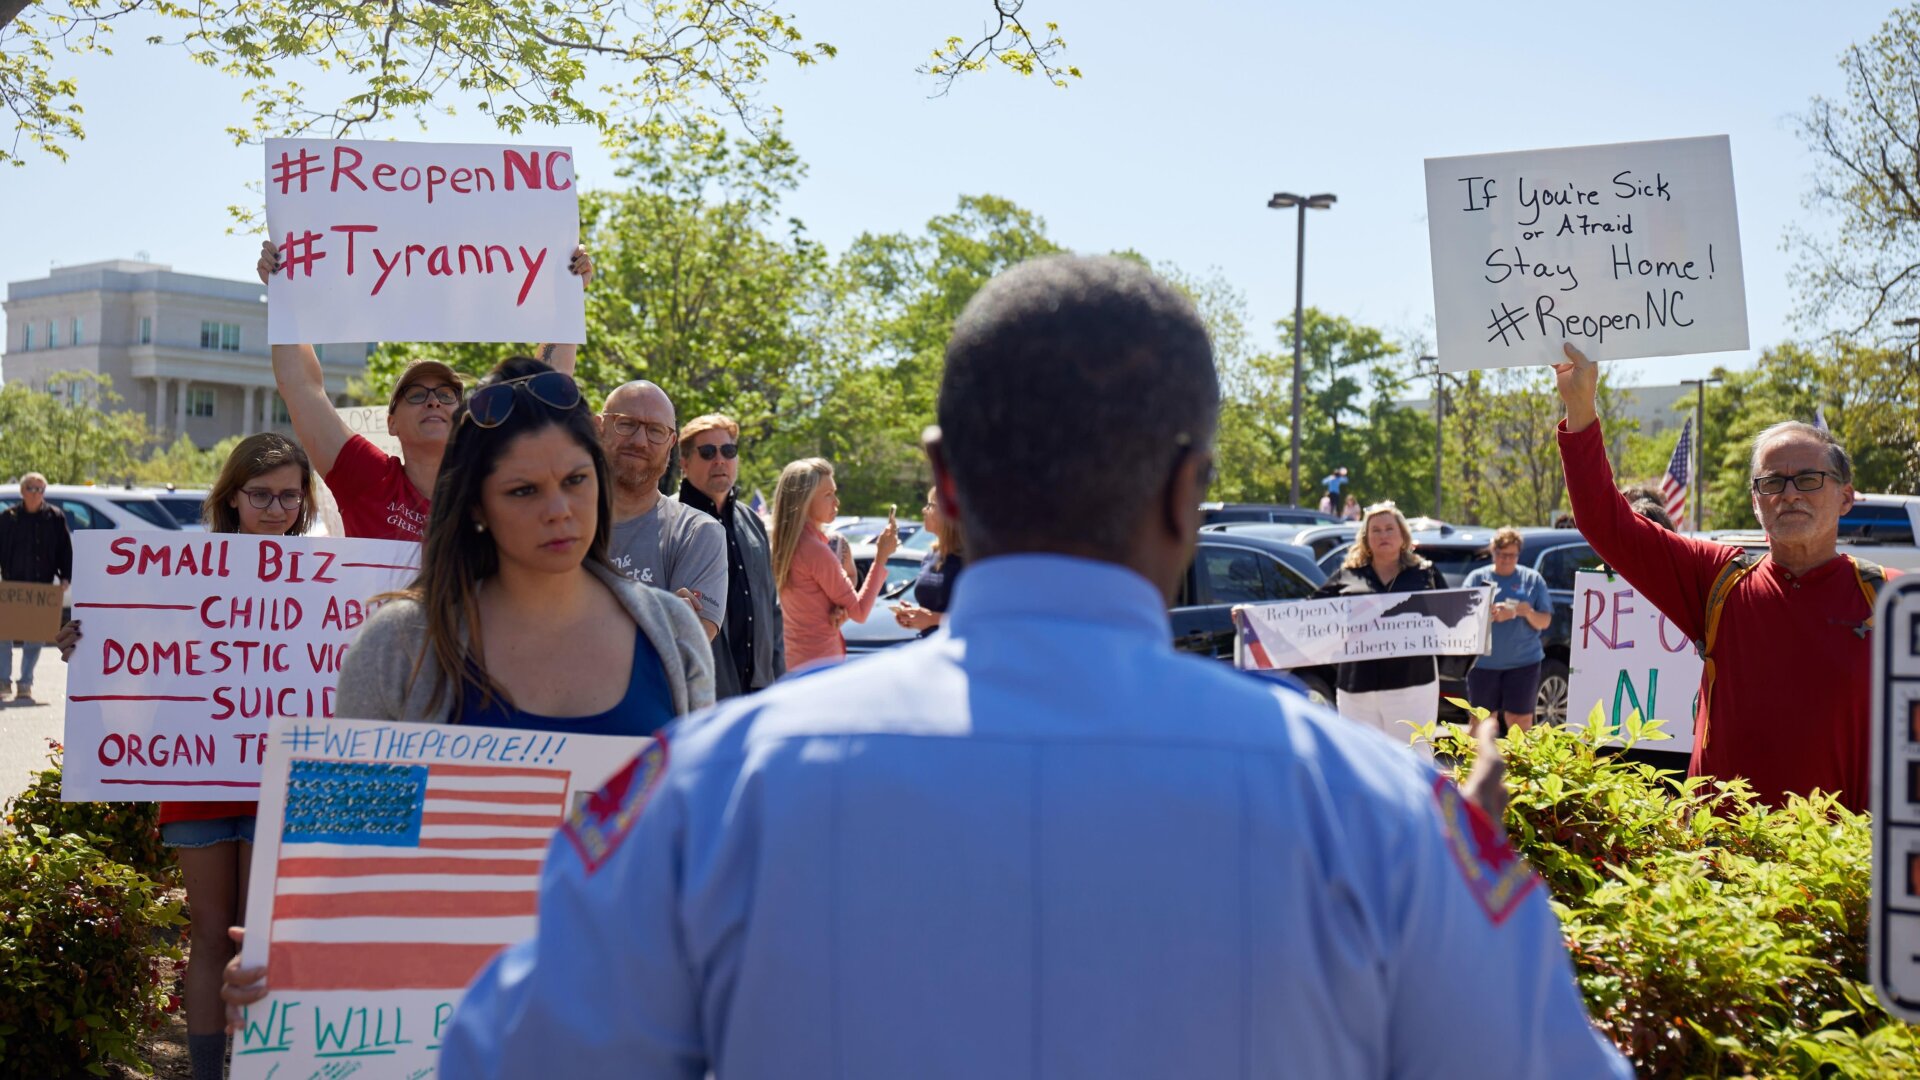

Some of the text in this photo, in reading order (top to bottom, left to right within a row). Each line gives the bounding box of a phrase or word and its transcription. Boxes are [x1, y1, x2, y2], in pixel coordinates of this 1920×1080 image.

[272, 146, 571, 203] #ReopenNC
[1458, 176, 1497, 211] If
[1613, 171, 1671, 201] Sick
[1523, 213, 1633, 240] or Afraid
[278, 224, 547, 306] #Tyranny
[1485, 243, 1715, 290] Stay Home!
[1487, 288, 1694, 346] #ReopenNC
[350, 409, 387, 433] OPE
[387, 514, 425, 537] GREA
[106, 537, 338, 583] SMALL BIZ
[200, 595, 303, 631] CHILD
[1297, 618, 1434, 640] #ReOpenAmerica
[102, 638, 290, 676] DOMESTIC
[1344, 634, 1477, 656] Liberty is Rising!
[98, 732, 216, 767] ORGAN
[281, 724, 567, 766] #WETHEPEOPLE!!!
[243, 1000, 300, 1046] WE
